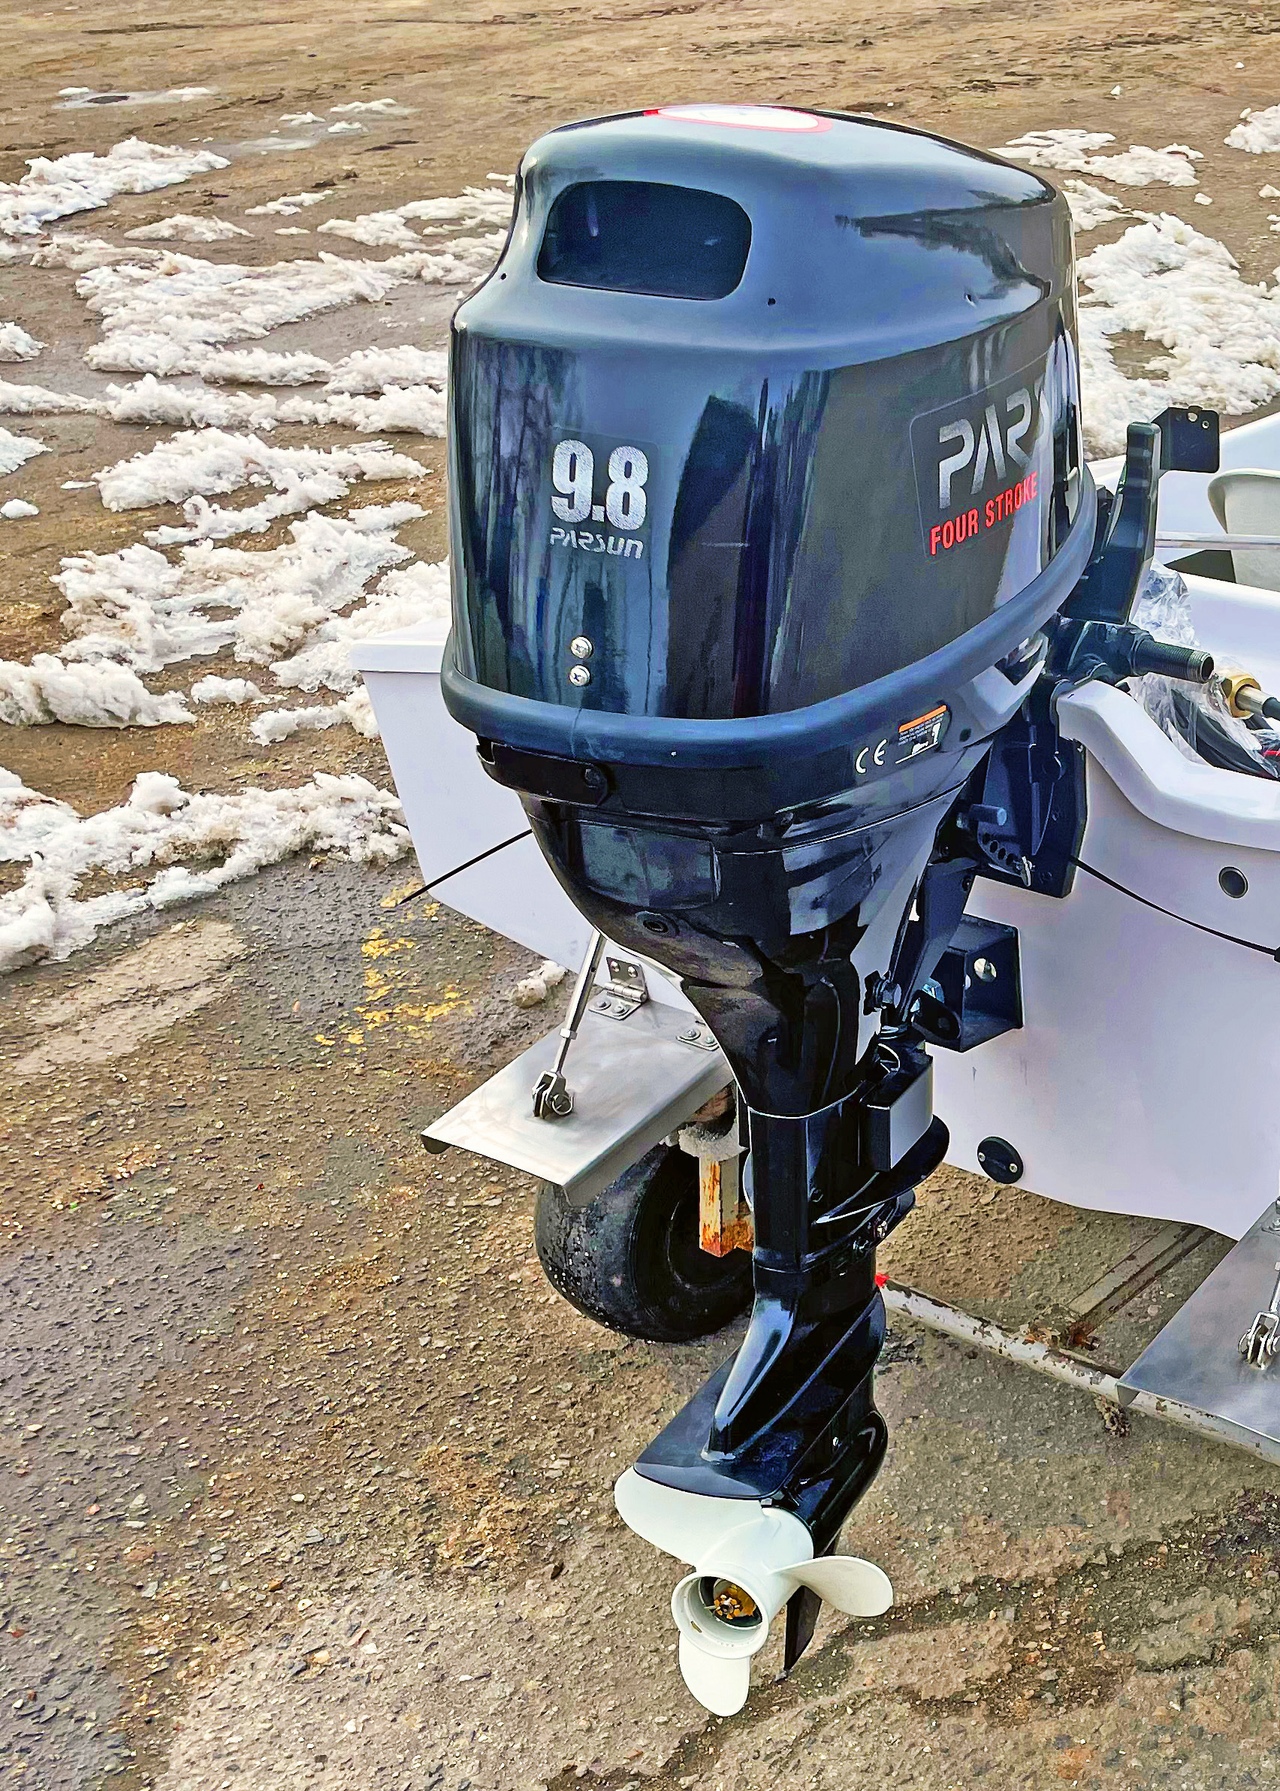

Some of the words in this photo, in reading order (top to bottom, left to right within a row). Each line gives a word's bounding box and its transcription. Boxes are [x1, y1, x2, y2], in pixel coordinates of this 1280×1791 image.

[551, 438, 649, 531] 9.8
[930, 508, 979, 556] FOUR
[985, 471, 1038, 528] STROKE
[855, 738, 887, 774] CE
